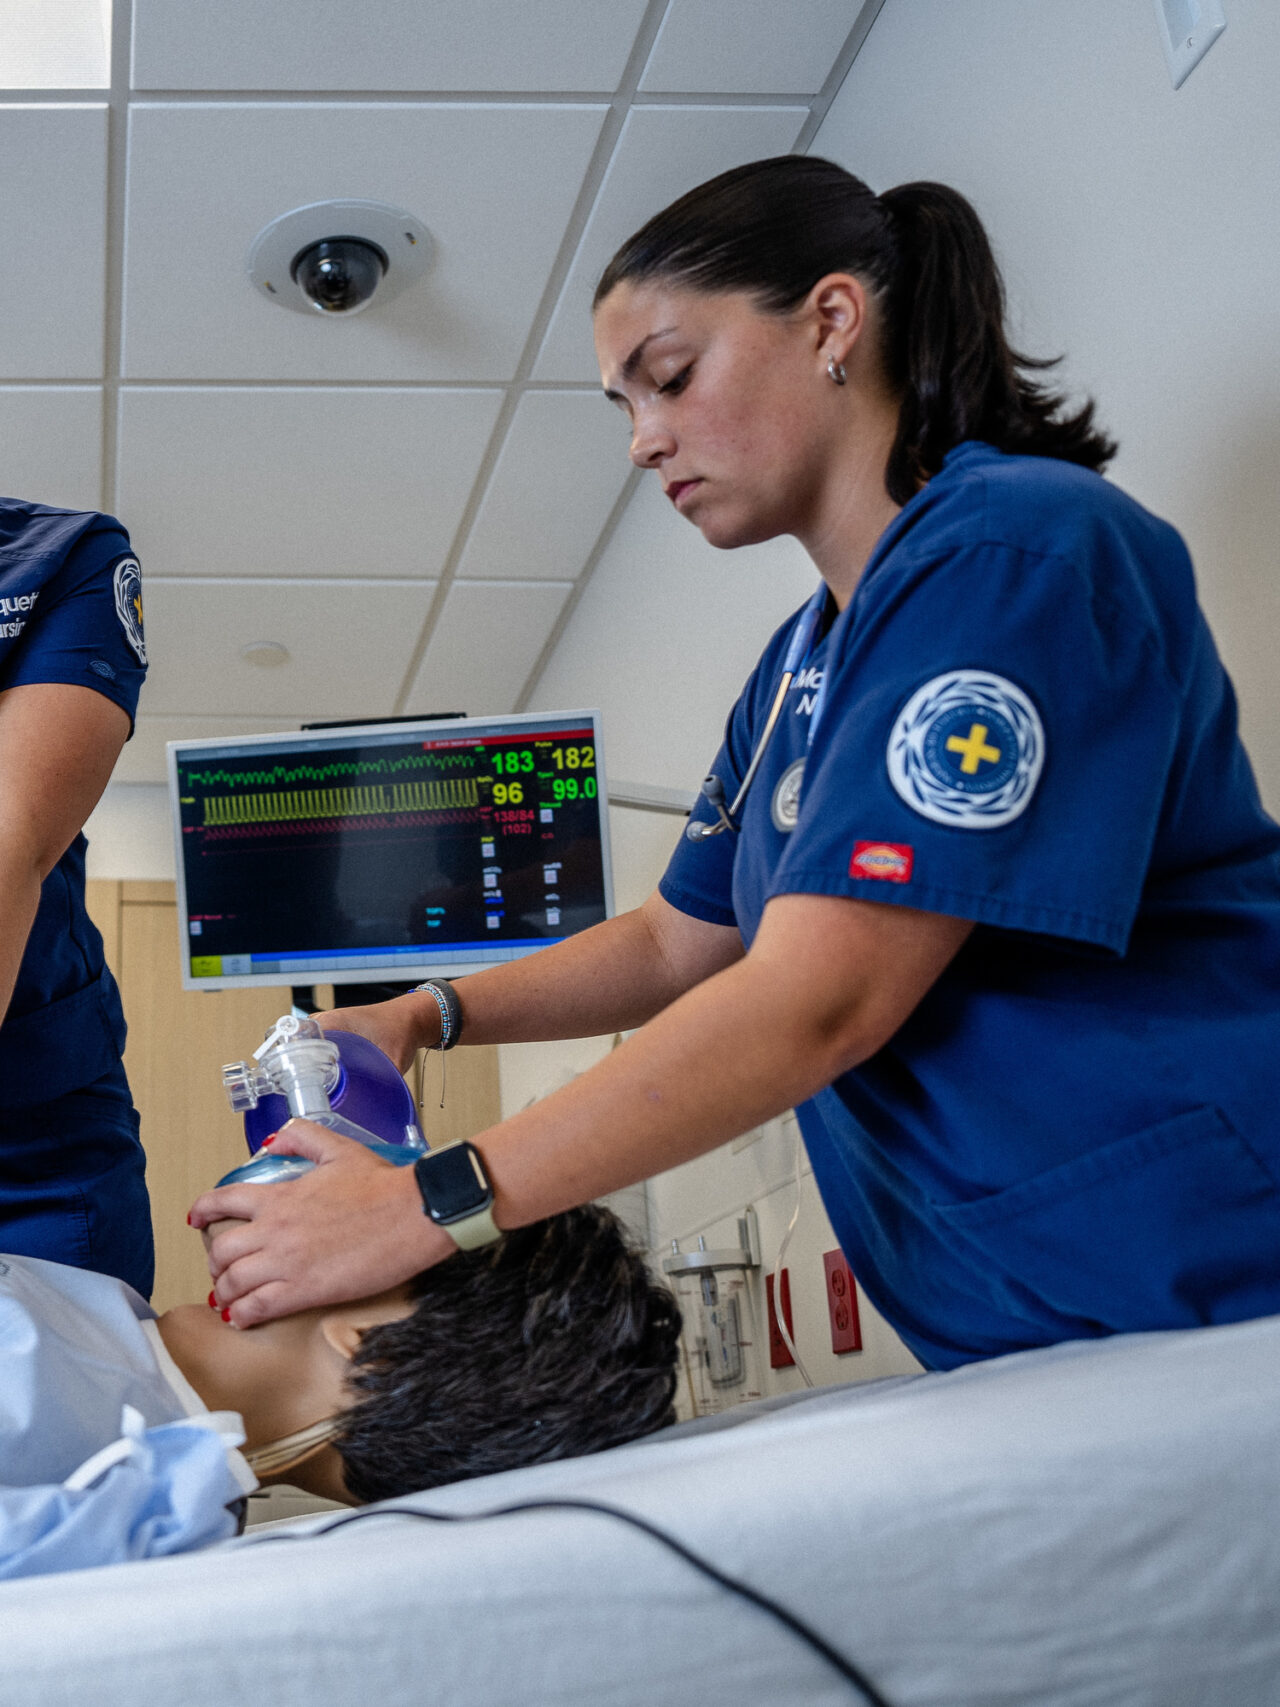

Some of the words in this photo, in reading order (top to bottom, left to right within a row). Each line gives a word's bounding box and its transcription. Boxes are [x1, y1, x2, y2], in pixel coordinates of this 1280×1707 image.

[491, 750, 535, 774] 183
[552, 746, 595, 770] 182
[492, 782, 524, 805] 96
[552, 776, 597, 800] 99.0
